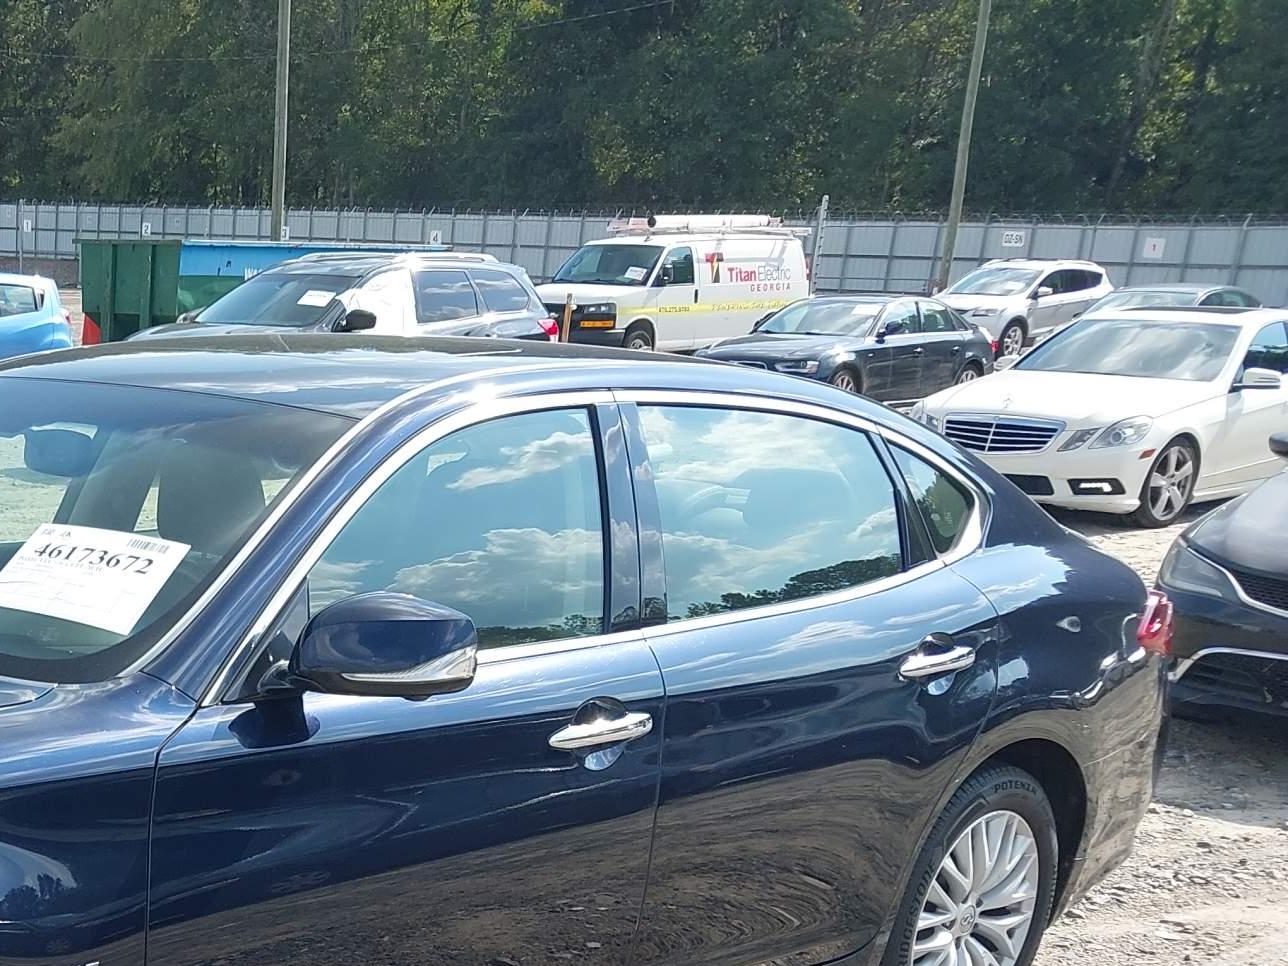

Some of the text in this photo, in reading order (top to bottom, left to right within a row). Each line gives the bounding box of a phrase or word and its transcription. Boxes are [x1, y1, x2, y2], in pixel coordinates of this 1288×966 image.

[728, 265, 791, 283] Titan Electric
[750, 283, 791, 293] GEORGIA
[34, 543, 154, 575] 46173672
